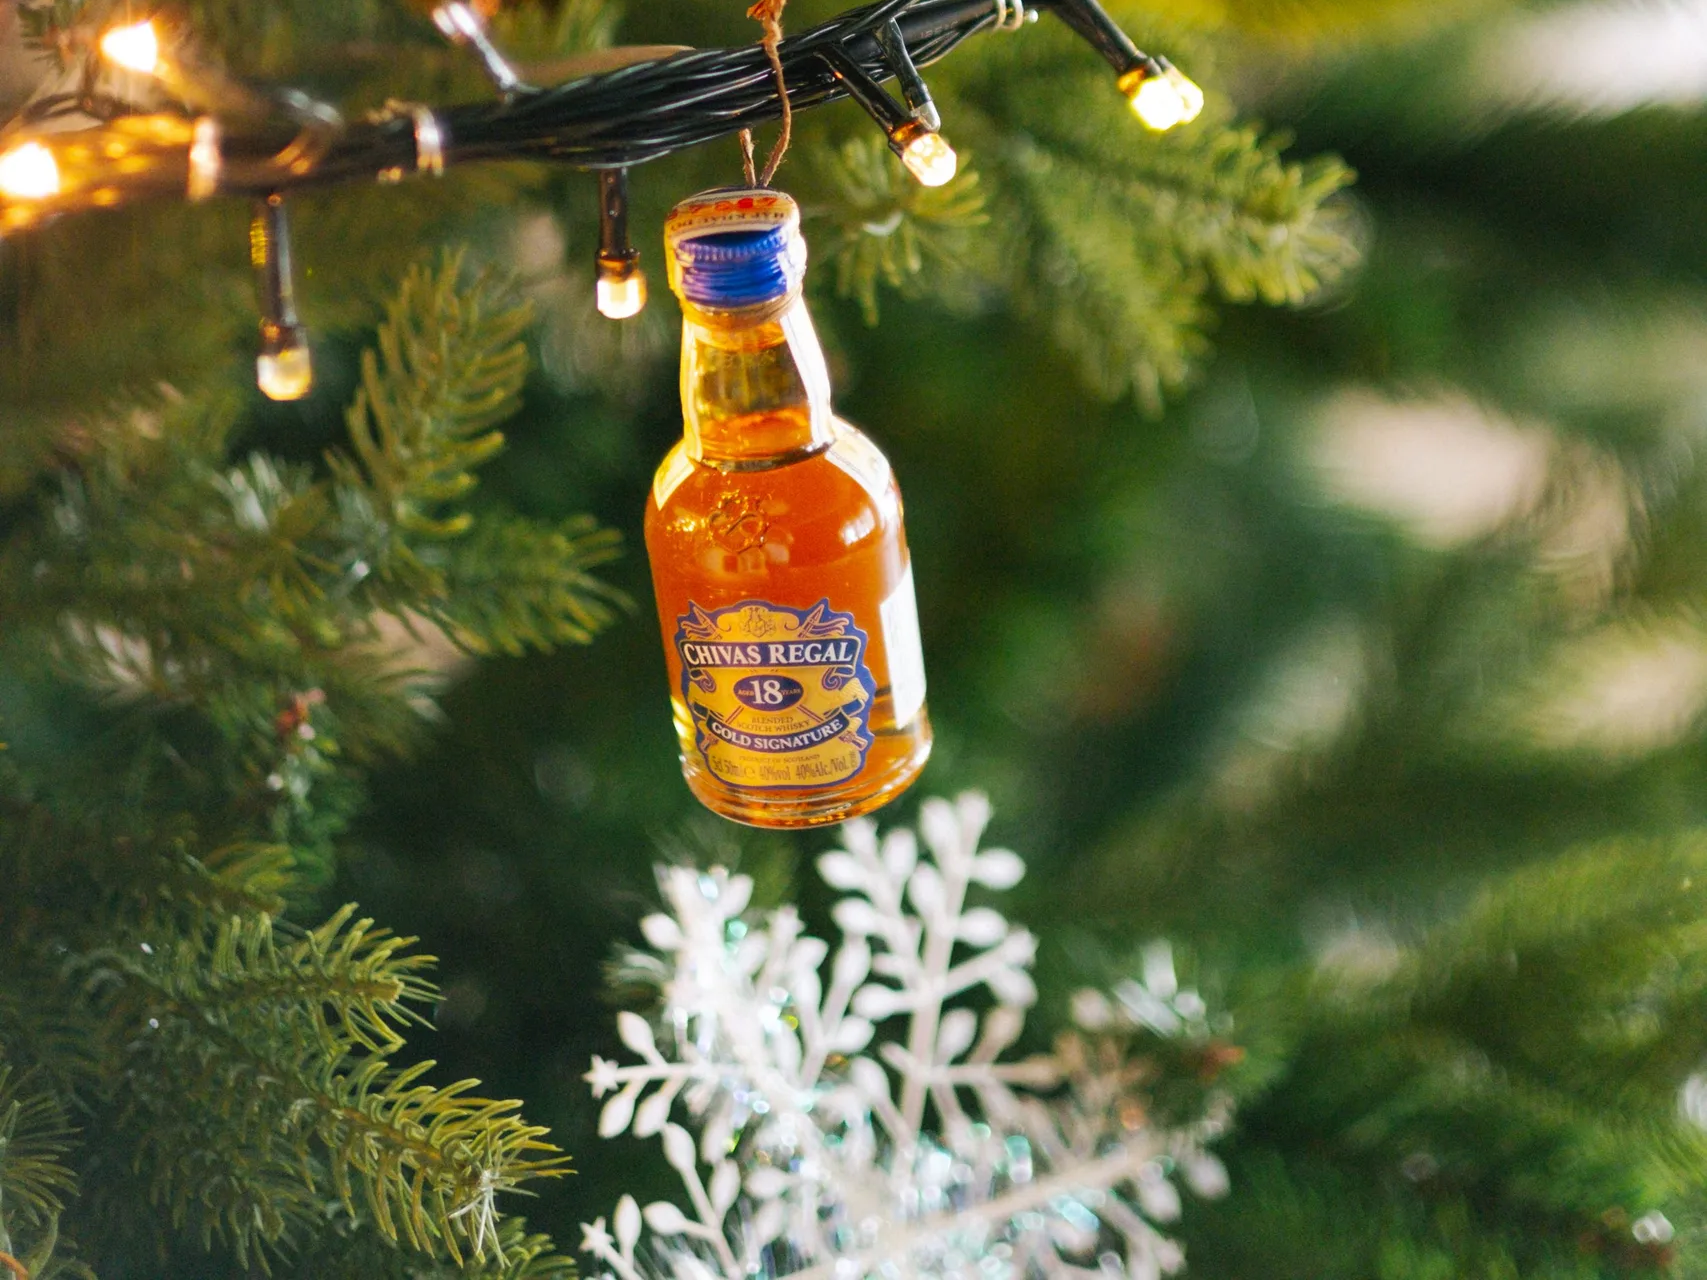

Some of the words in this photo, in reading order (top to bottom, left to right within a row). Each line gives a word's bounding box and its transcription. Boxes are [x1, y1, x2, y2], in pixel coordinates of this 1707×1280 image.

[683, 642, 762, 666] CHIVAS
[768, 641, 854, 664] REGAL
[750, 679, 784, 705] 18
[736, 721, 772, 732] SCOTCH
[775, 720, 810, 732] WHISKY
[751, 716, 794, 724] BLENDED
[711, 720, 752, 747] GOLD
[754, 718, 844, 750] SIGNATURE
